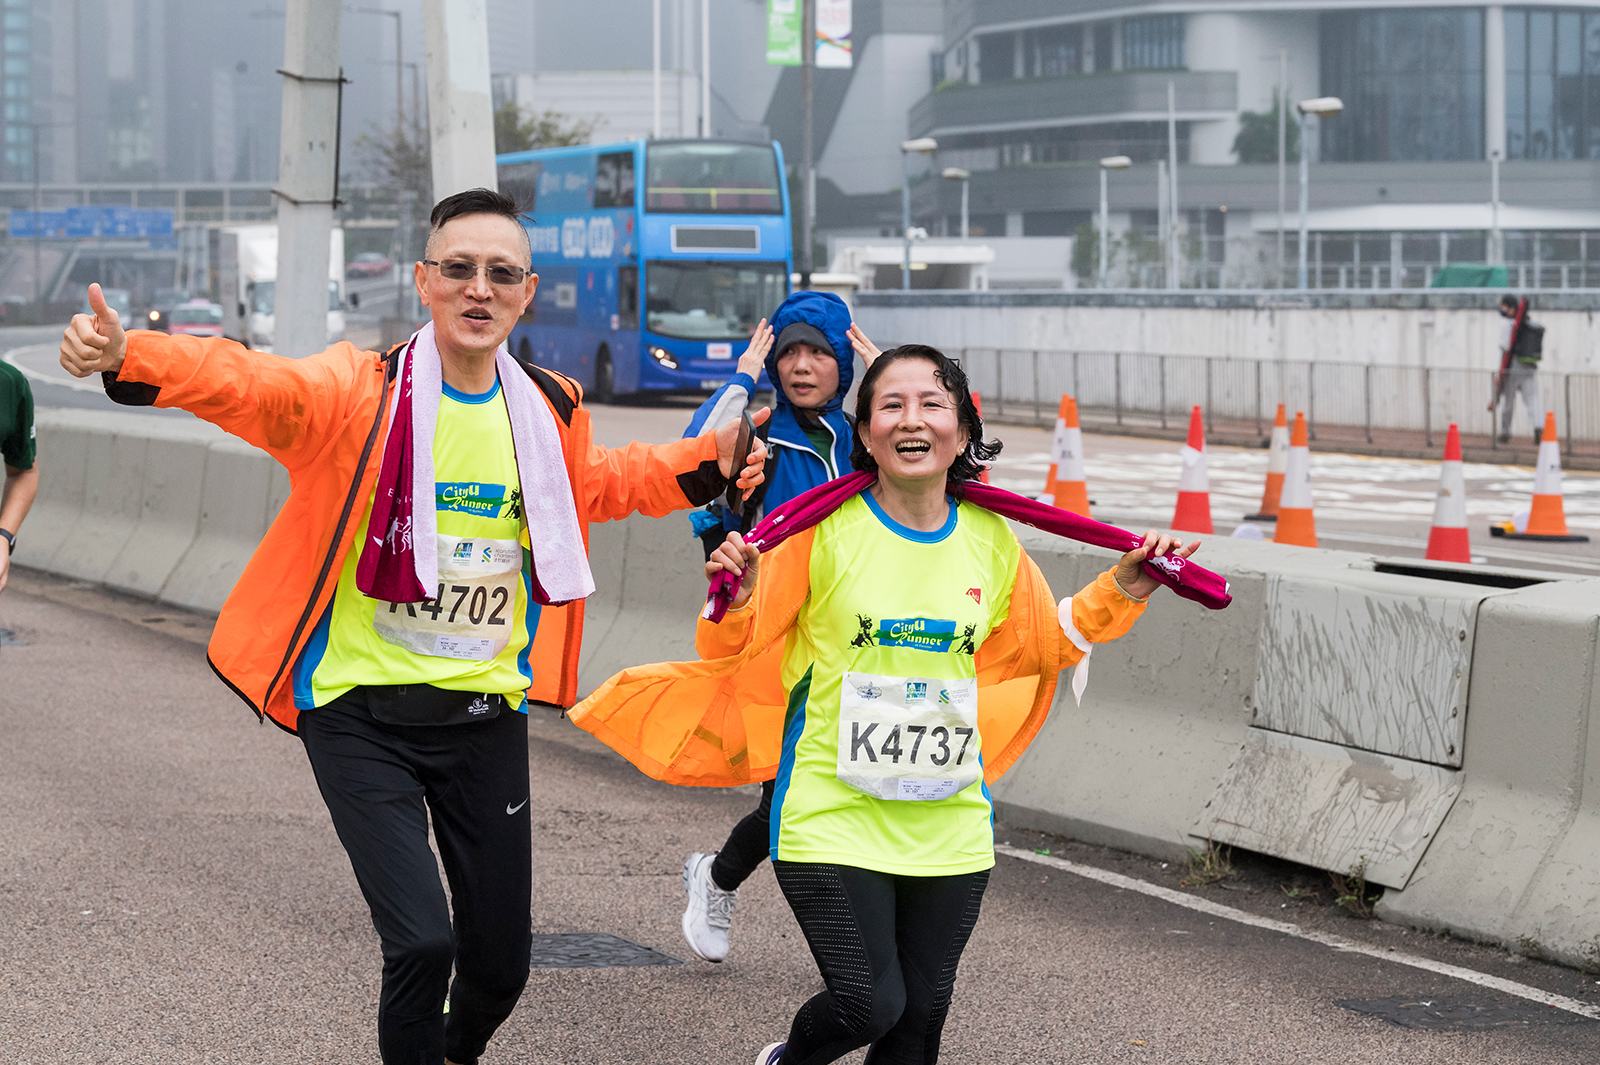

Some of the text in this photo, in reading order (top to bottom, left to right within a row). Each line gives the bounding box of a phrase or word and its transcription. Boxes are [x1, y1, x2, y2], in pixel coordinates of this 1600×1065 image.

[442, 484, 480, 502] CityU
[889, 619, 925, 638] CityU
[895, 632, 943, 646] Runner
[850, 721, 974, 767] K4737
